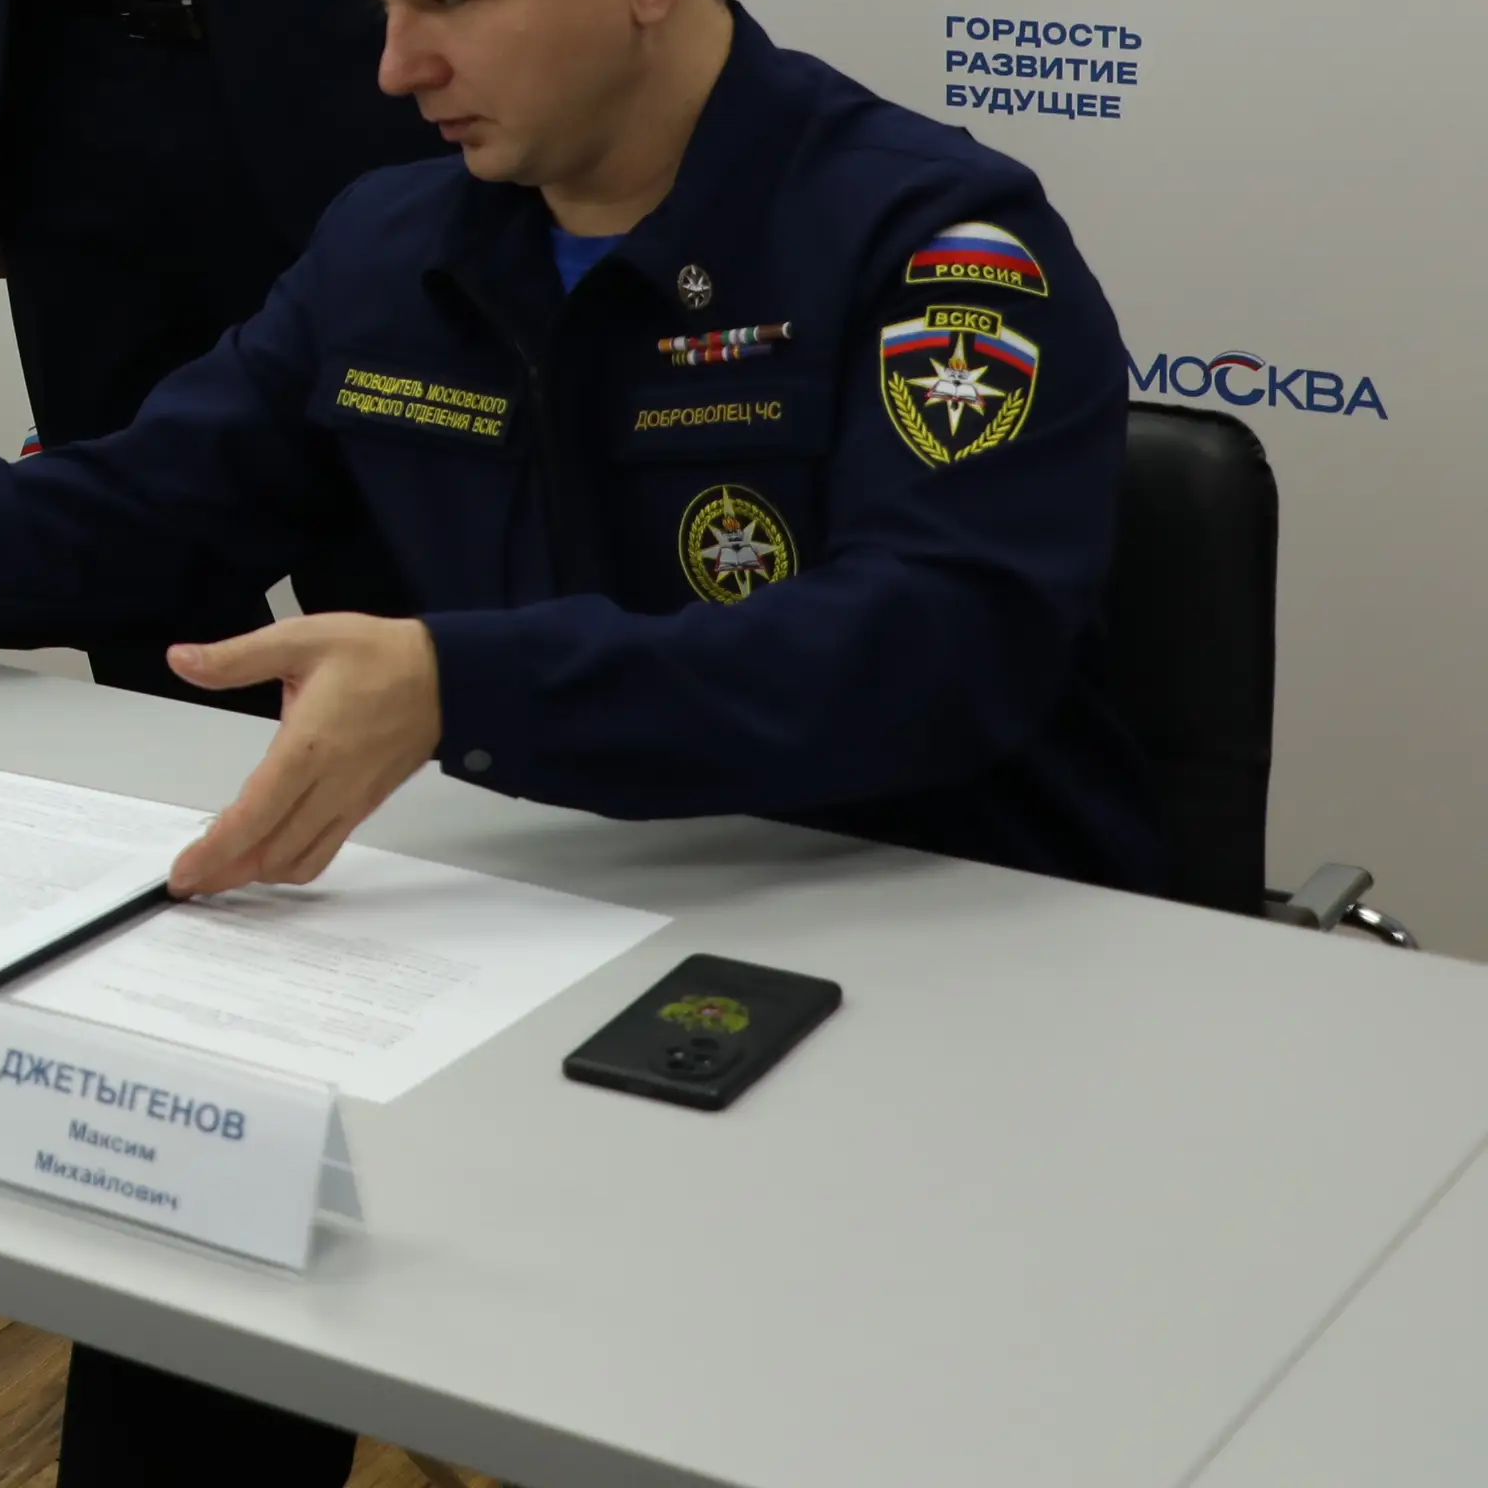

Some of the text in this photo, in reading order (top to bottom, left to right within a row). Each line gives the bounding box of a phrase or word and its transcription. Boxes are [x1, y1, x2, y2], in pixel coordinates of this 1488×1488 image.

[947, 16, 1141, 49] ГОРДОСТЬ
[946, 50, 1137, 85] РАЗВИТИЕ
[946, 84, 1120, 120] БУДУЩЕЕ
[935, 264, 1022, 286] РОССИЯ
[935, 312, 992, 330] ВСКС
[345, 368, 508, 414] РУКОВОДИТЕЛЬ МОСКОВСКОГО
[1127, 350, 1388, 420] МОСКВА
[337, 389, 502, 436] ГОРОДСКОГО ОТДЕЛЕНИЯ ВСКС
[635, 401, 781, 430] ДОБРОВОЛЕЦ ЧС
[68, 1118, 156, 1163] Максим
[34, 1150, 179, 1211] Михайлович
